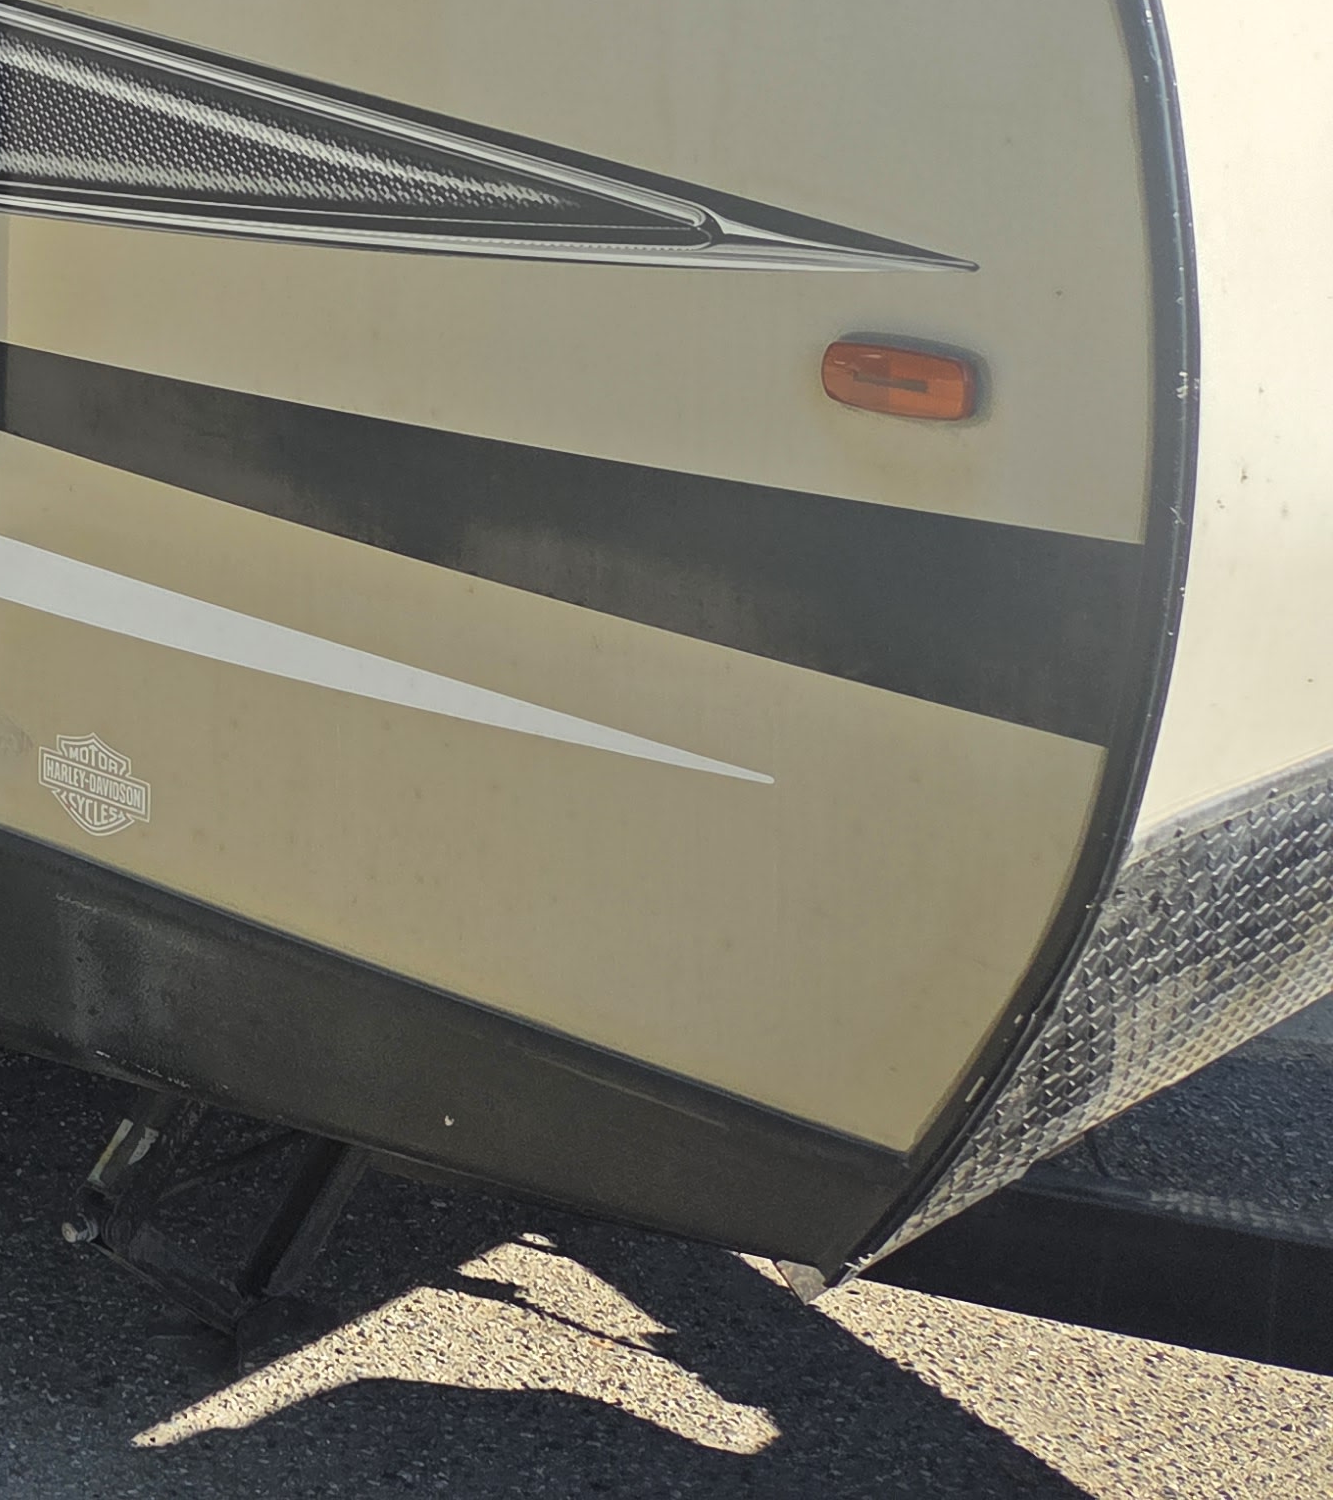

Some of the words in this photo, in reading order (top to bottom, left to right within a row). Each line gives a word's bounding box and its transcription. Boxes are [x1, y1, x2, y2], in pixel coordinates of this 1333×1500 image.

[69, 745, 118, 776] MOTOR
[46, 759, 141, 808] HARLEY-DAVIDSON
[68, 792, 118, 825] CYCLES
